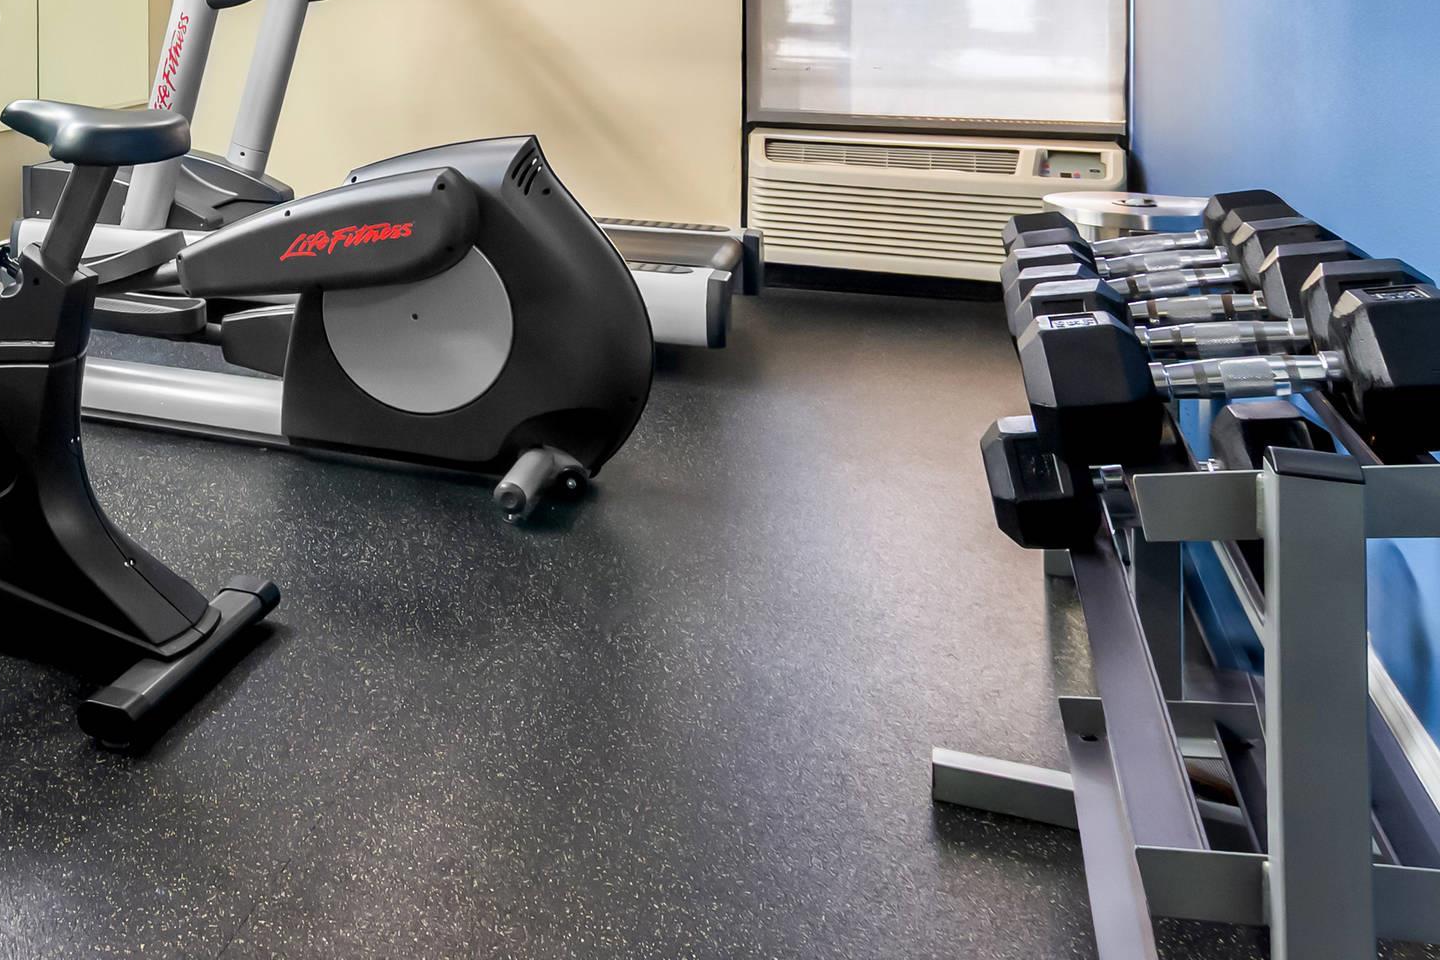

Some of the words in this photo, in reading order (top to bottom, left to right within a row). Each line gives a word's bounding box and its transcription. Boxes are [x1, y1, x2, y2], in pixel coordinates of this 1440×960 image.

[162, 11, 189, 92] Fitness
[279, 230, 330, 261] Life
[328, 222, 413, 255] Fitness
